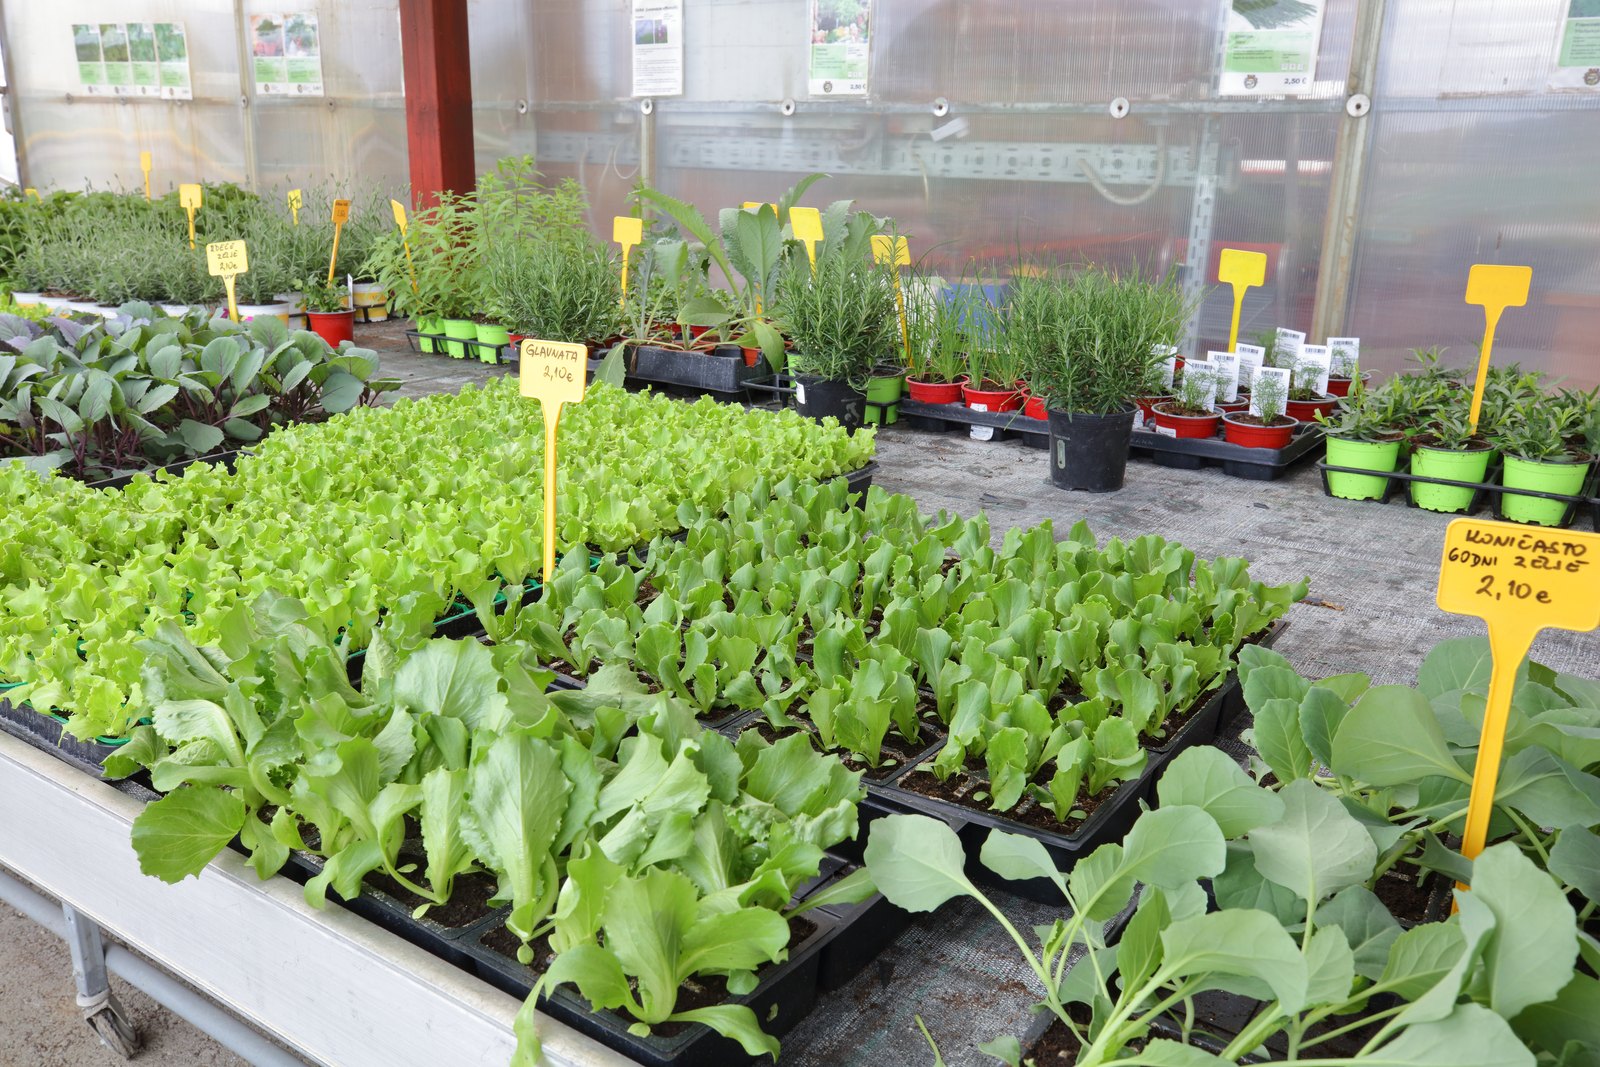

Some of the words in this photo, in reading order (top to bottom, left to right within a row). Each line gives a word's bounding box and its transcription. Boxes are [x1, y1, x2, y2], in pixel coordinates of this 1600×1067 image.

[1284, 77, 1300, 85] 2,50
[525, 343, 578, 363] GLAVNATA
[1465, 529, 1587, 557] KONIČASTO
